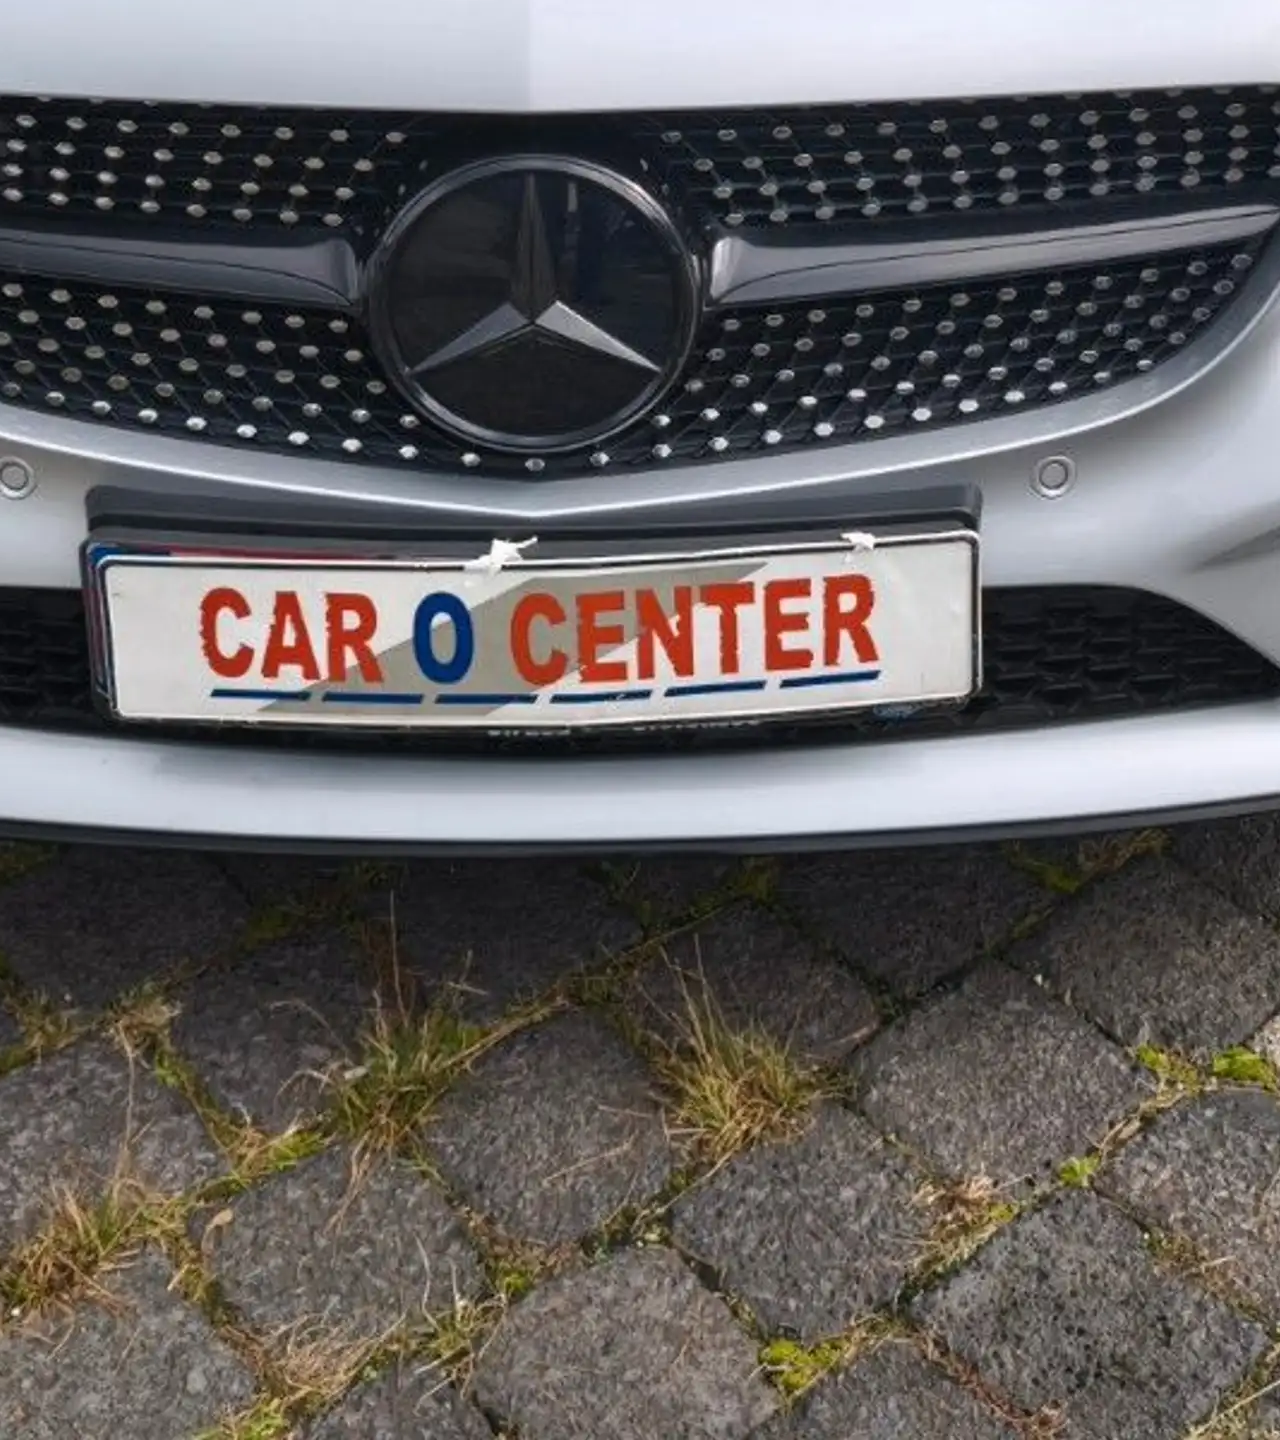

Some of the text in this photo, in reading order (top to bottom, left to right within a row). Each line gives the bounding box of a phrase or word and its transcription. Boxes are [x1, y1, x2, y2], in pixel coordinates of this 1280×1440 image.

[199, 573, 880, 688] CAR O CENTER
